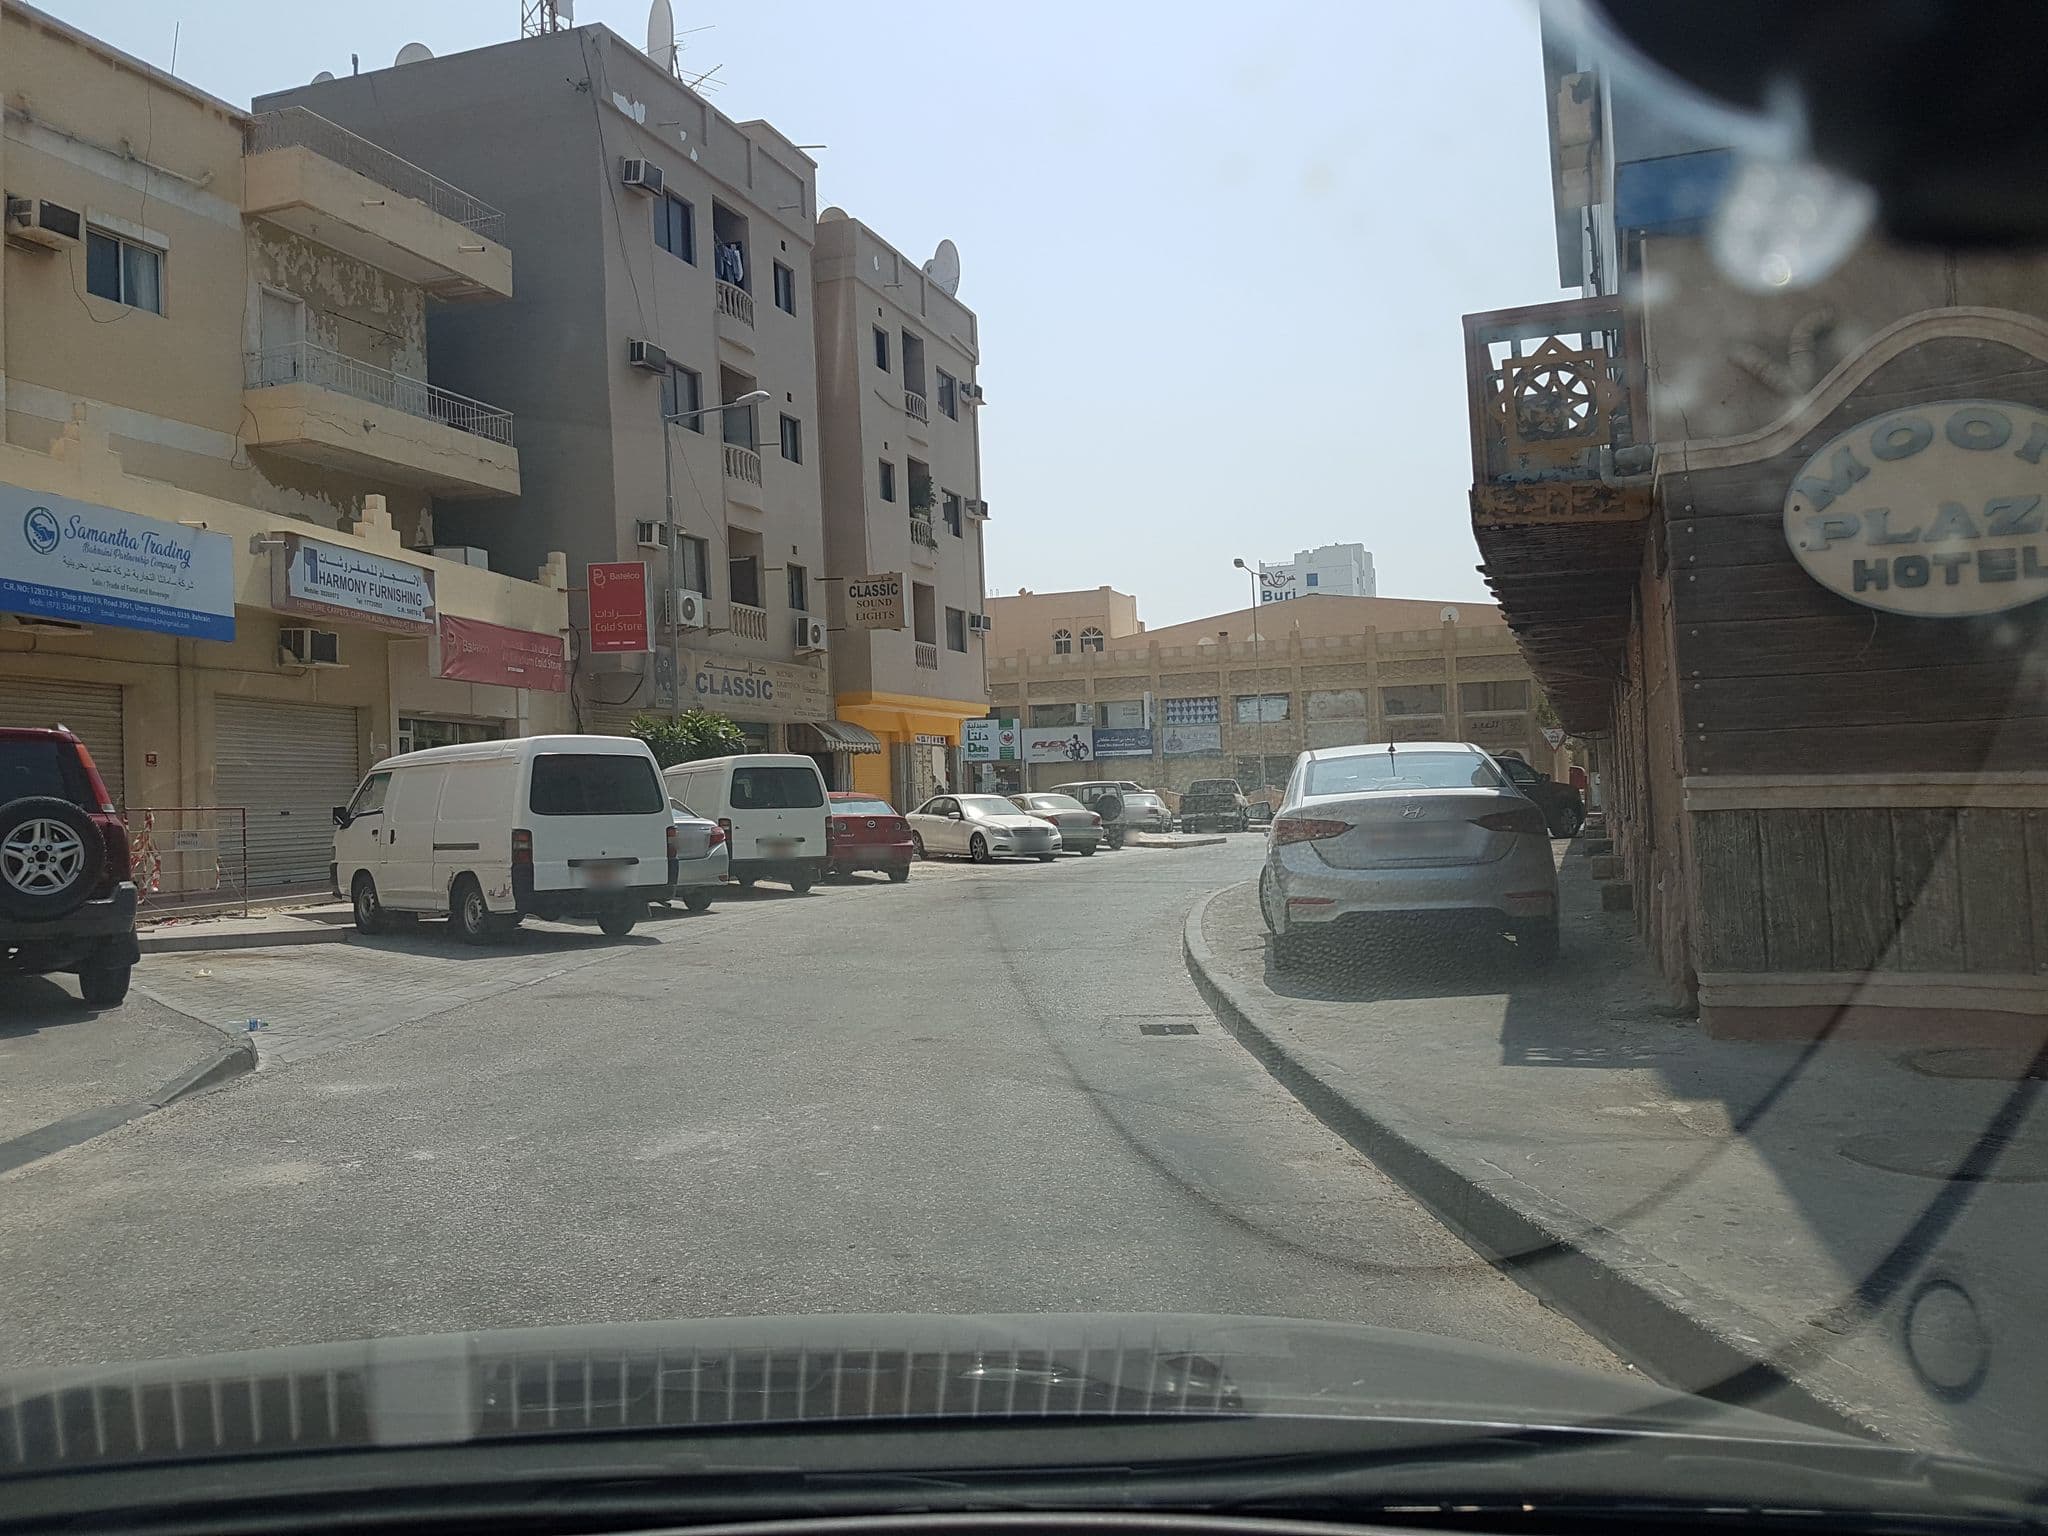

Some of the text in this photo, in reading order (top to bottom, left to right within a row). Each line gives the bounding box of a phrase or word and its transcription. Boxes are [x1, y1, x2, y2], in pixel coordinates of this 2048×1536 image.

[1804, 495, 2048, 551] PLAZ
[64, 515, 191, 569] Samantha Trading
[609, 572, 640, 581] Batelco
[1852, 546, 2048, 592] HOTEL
[319, 571, 367, 594] HARMONY
[369, 582, 422, 606] FURNISHING
[849, 583, 898, 598] CLASSIC
[856, 599, 892, 608] SOUND
[856, 610, 895, 621] LIGHTS
[595, 623, 645, 632] Cold Store
[695, 672, 774, 700] CLASSIC
[968, 729, 989, 741] دلتا
